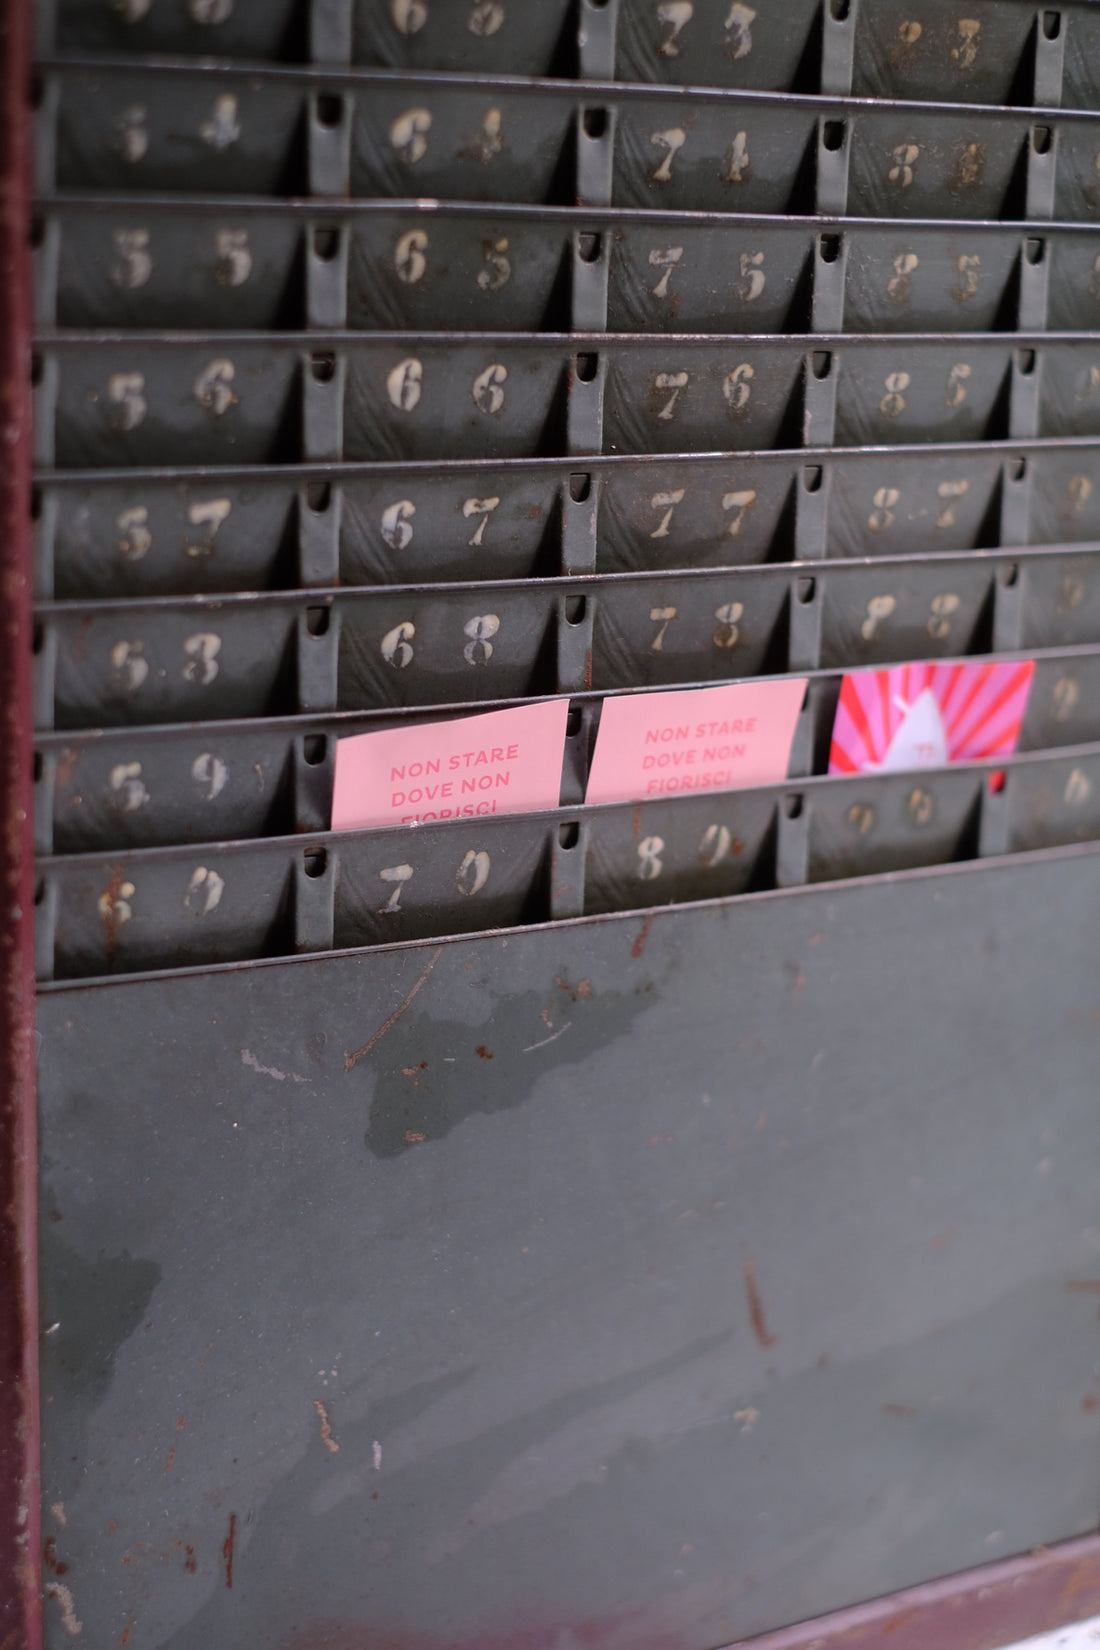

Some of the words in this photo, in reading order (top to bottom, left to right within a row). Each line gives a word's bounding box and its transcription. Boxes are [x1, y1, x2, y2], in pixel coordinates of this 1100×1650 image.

[111, 228, 251, 287] 55
[649, 247, 765, 299] 75
[109, 359, 235, 430] 56
[388, 358, 507, 414] 66
[655, 364, 754, 419] 76
[117, 499, 231, 560] 57
[382, 497, 499, 549] 67
[651, 489, 756, 537] 77
[381, 614, 499, 669] 68
[642, 749, 697, 770] DOVE
[702, 744, 747, 763] NON
[644, 725, 690, 745] NON
[695, 717, 758, 739] STARE
[390, 758, 441, 782] NON
[448, 744, 519, 771] STARE
[646, 771, 732, 794] FIORISCI
[391, 782, 453, 807] DOVE
[461, 772, 510, 794] NON
